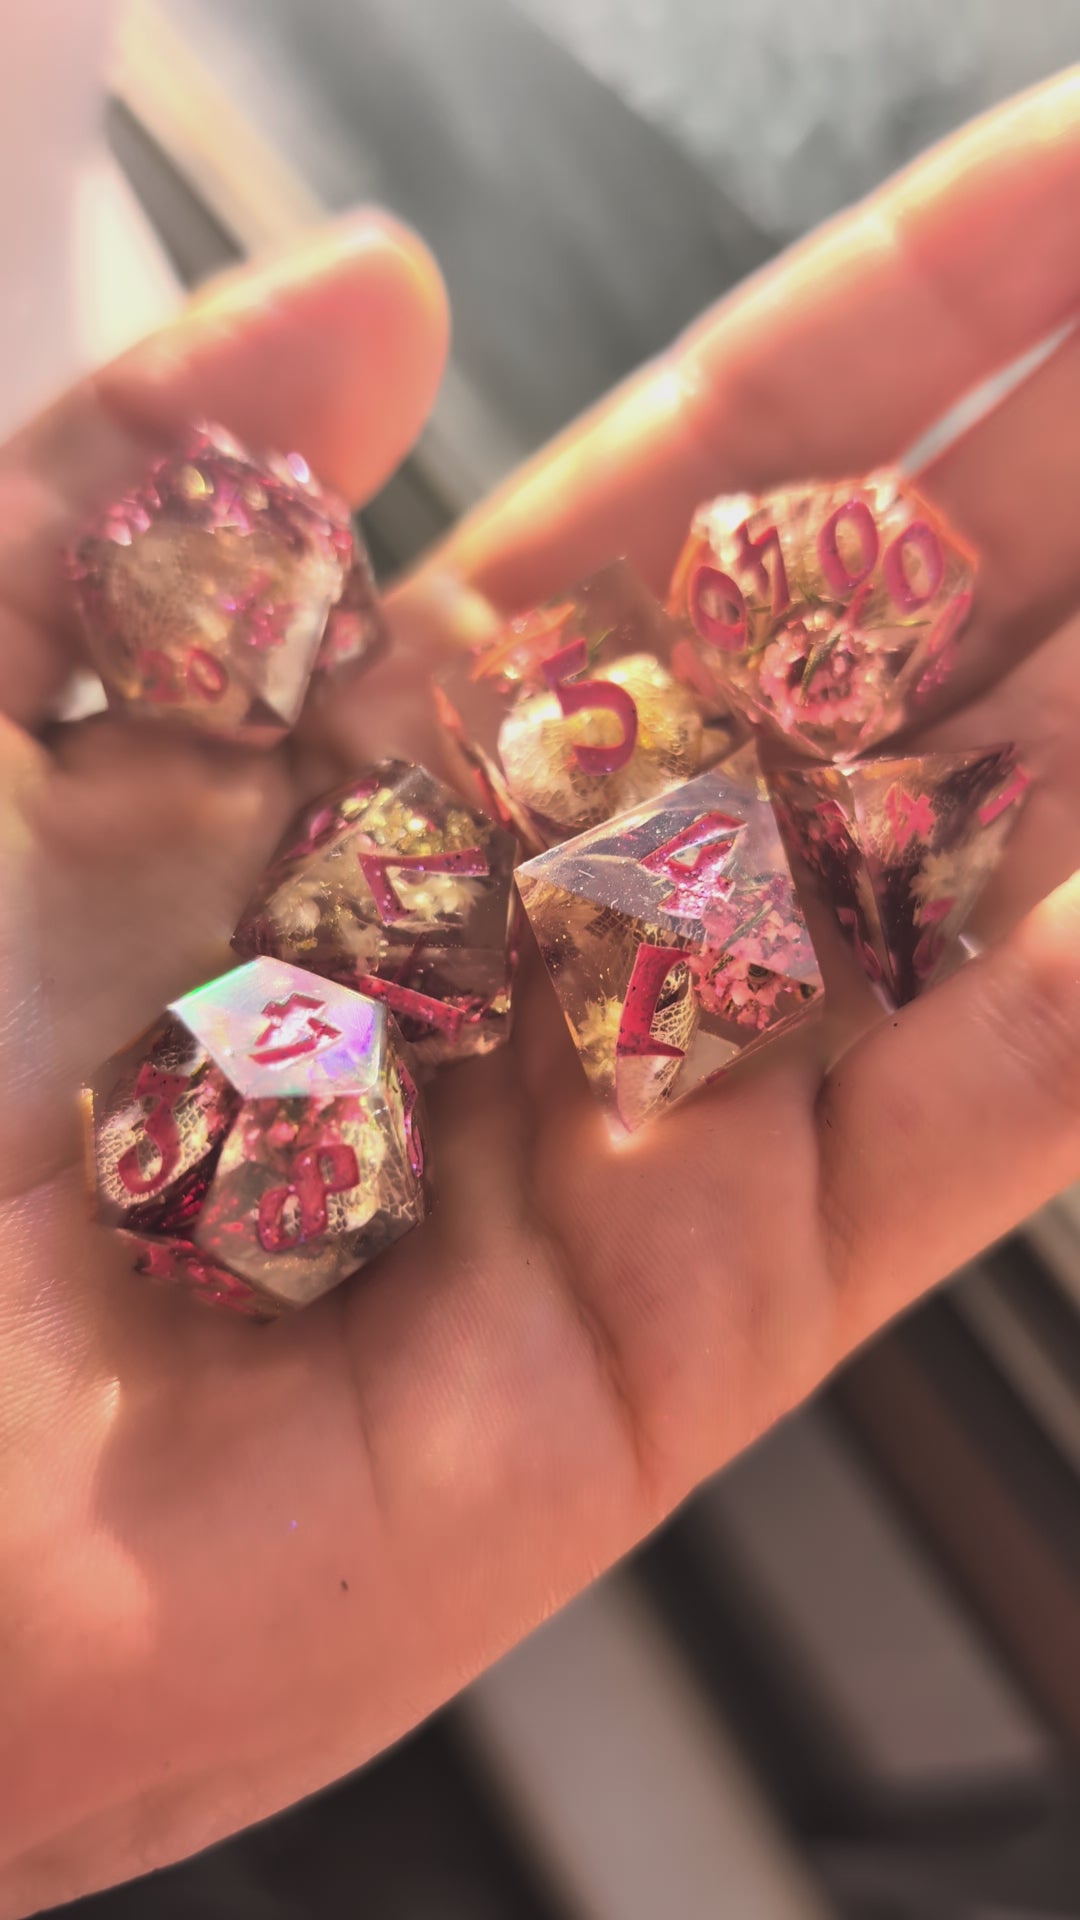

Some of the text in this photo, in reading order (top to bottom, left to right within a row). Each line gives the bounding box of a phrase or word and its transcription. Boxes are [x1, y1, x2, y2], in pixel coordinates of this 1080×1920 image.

[817, 499, 944, 615] 00
[541, 638, 639, 777] 5
[357, 847, 491, 926] 7
[638, 810, 748, 920] 4
[257, 1143, 360, 1251] 8
